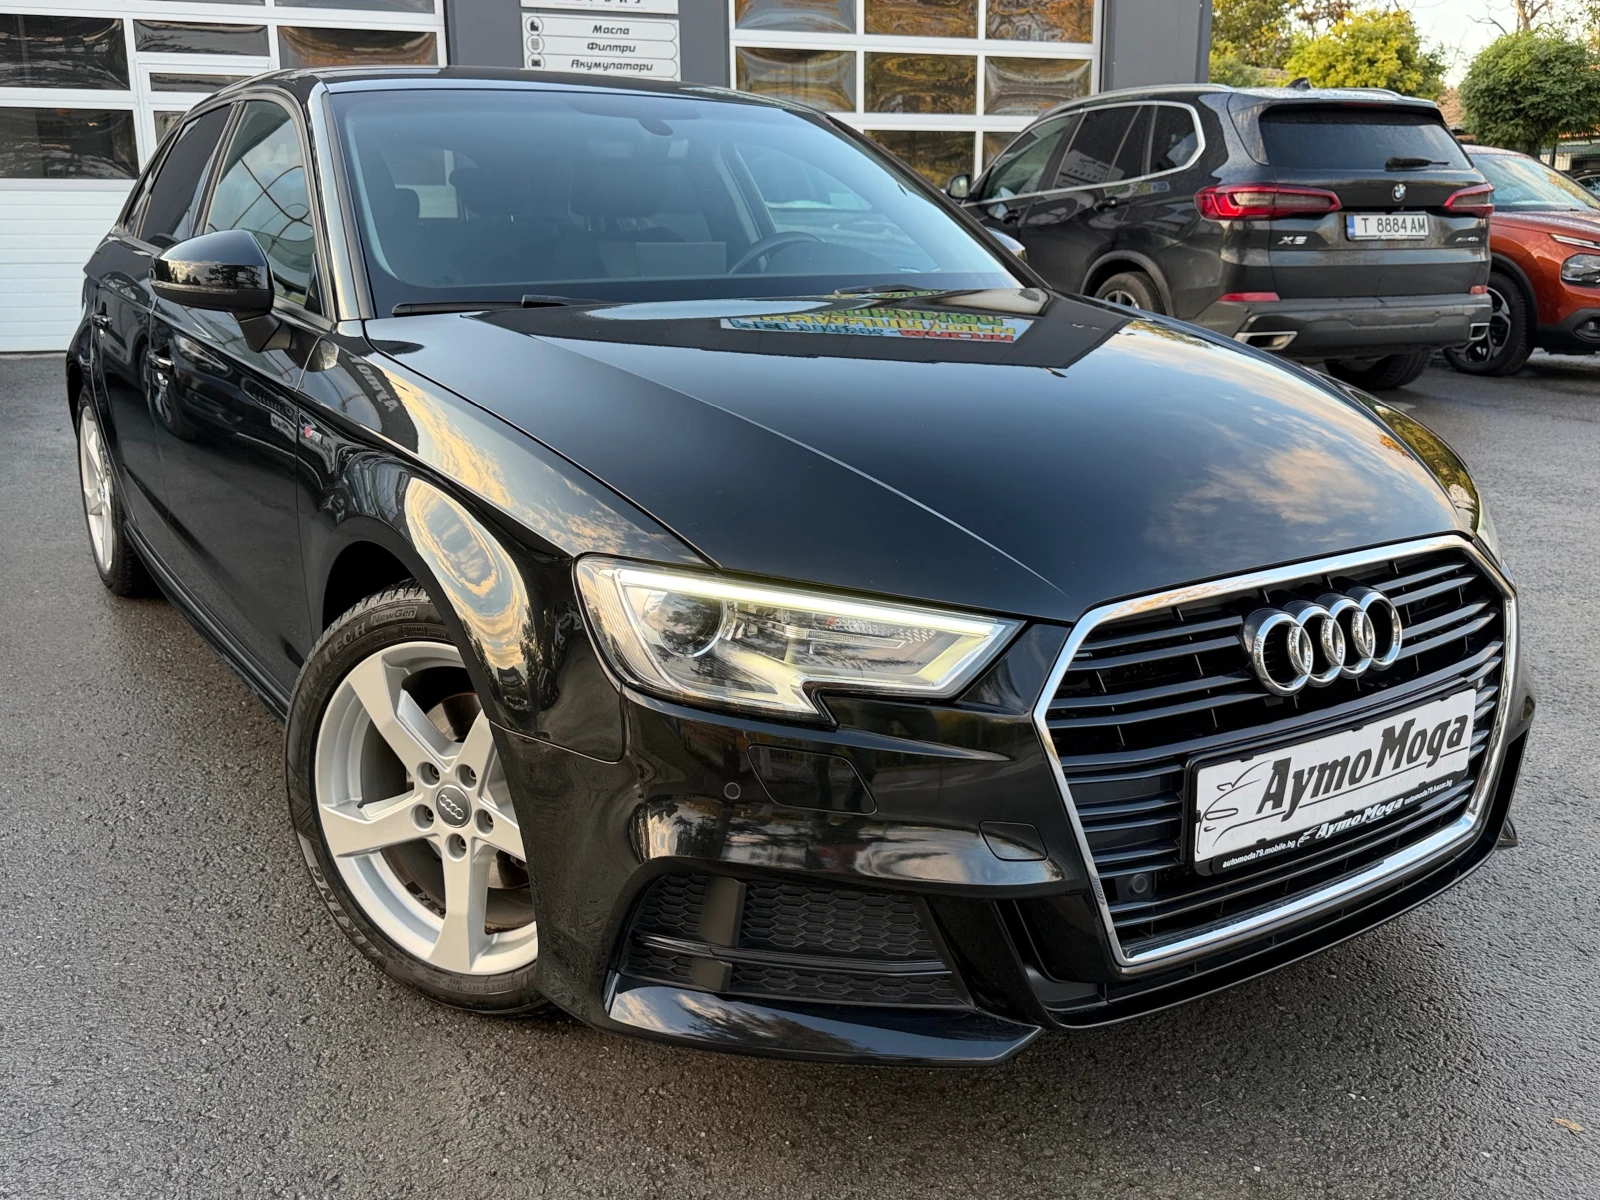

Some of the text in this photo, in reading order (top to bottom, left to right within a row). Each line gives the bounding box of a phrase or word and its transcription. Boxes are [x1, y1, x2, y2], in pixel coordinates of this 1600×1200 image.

[592, 25, 630, 36] Масла
[587, 42, 636, 54] Филтри
[1361, 217, 1426, 233] T 8884 AM
[1277, 235, 1308, 245] X5
[372, 608, 416, 625] NewGen
[1222, 840, 1296, 868] automoda79.mobile.bg
